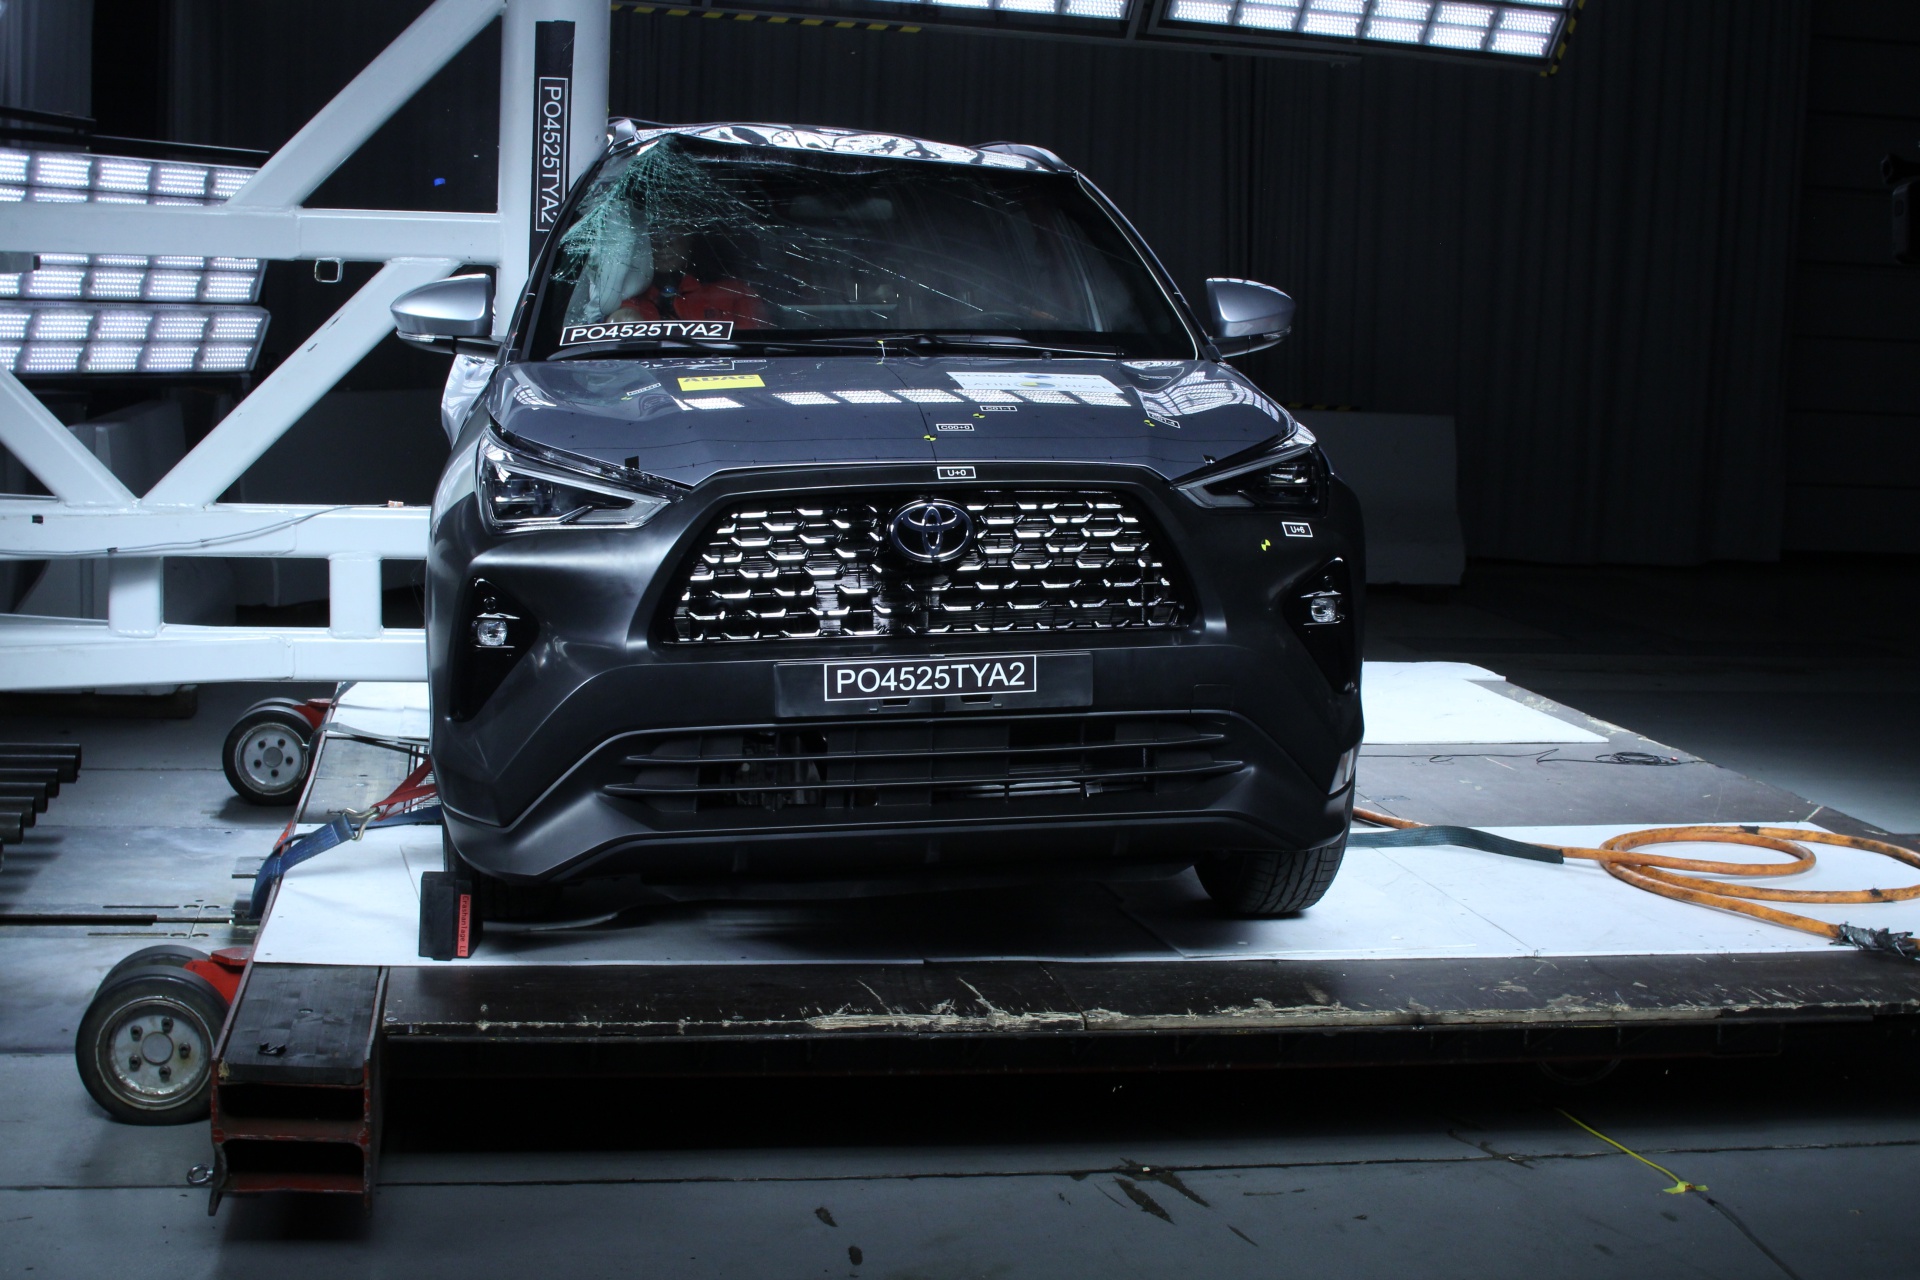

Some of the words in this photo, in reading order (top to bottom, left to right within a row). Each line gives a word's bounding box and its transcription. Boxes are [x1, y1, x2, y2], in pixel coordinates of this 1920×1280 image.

[541, 86, 562, 223] PO4525TYA2
[570, 323, 724, 342] PO4525TYA2
[683, 375, 756, 383] ADAC
[947, 469, 967, 477] U+0
[1289, 525, 1306, 534] U+6
[836, 661, 1026, 694] PO4525TYA2
